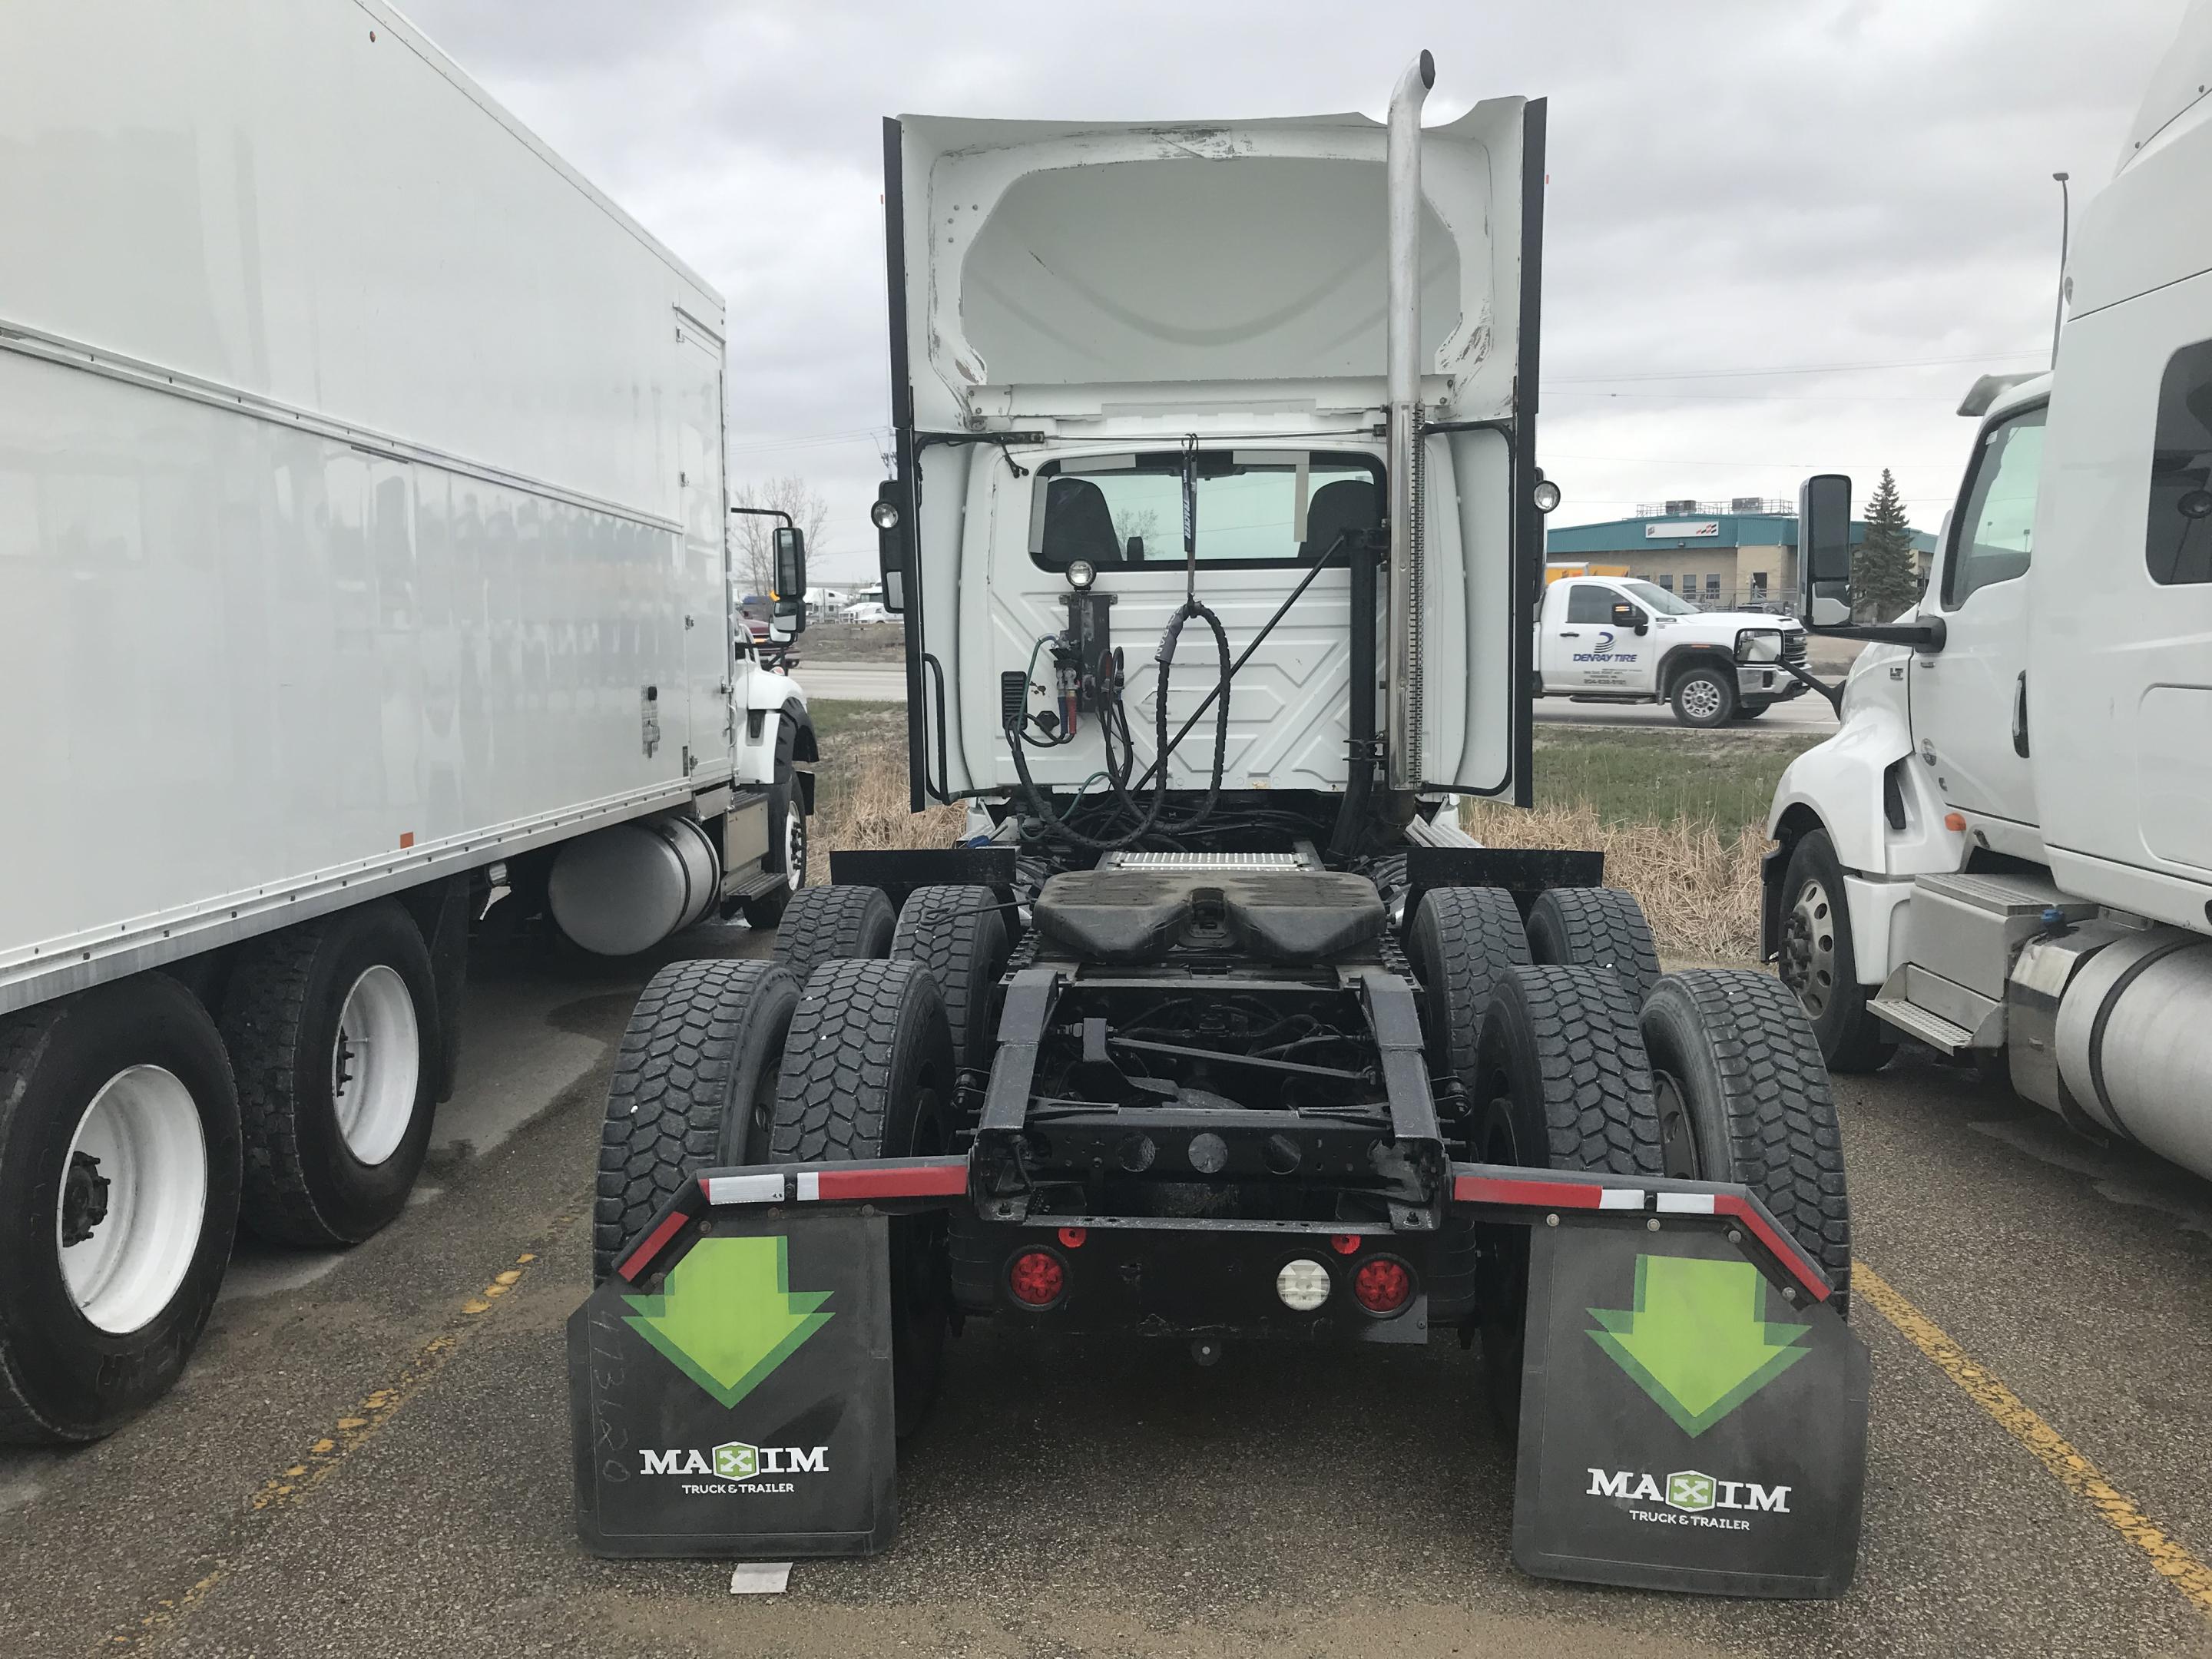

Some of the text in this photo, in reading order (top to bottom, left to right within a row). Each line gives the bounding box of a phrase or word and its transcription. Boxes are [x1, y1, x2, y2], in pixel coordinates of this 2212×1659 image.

[1183, 499, 1191, 539] TRACKER
[1573, 654, 1613, 662] DENRAY
[638, 1445, 830, 1476] MAXIM
[682, 1483, 794, 1494] TRUCK & TRAILER
[1586, 1468, 1792, 1513] MAXIM
[1629, 1509, 1750, 1530] TRUCK & TRAILER
